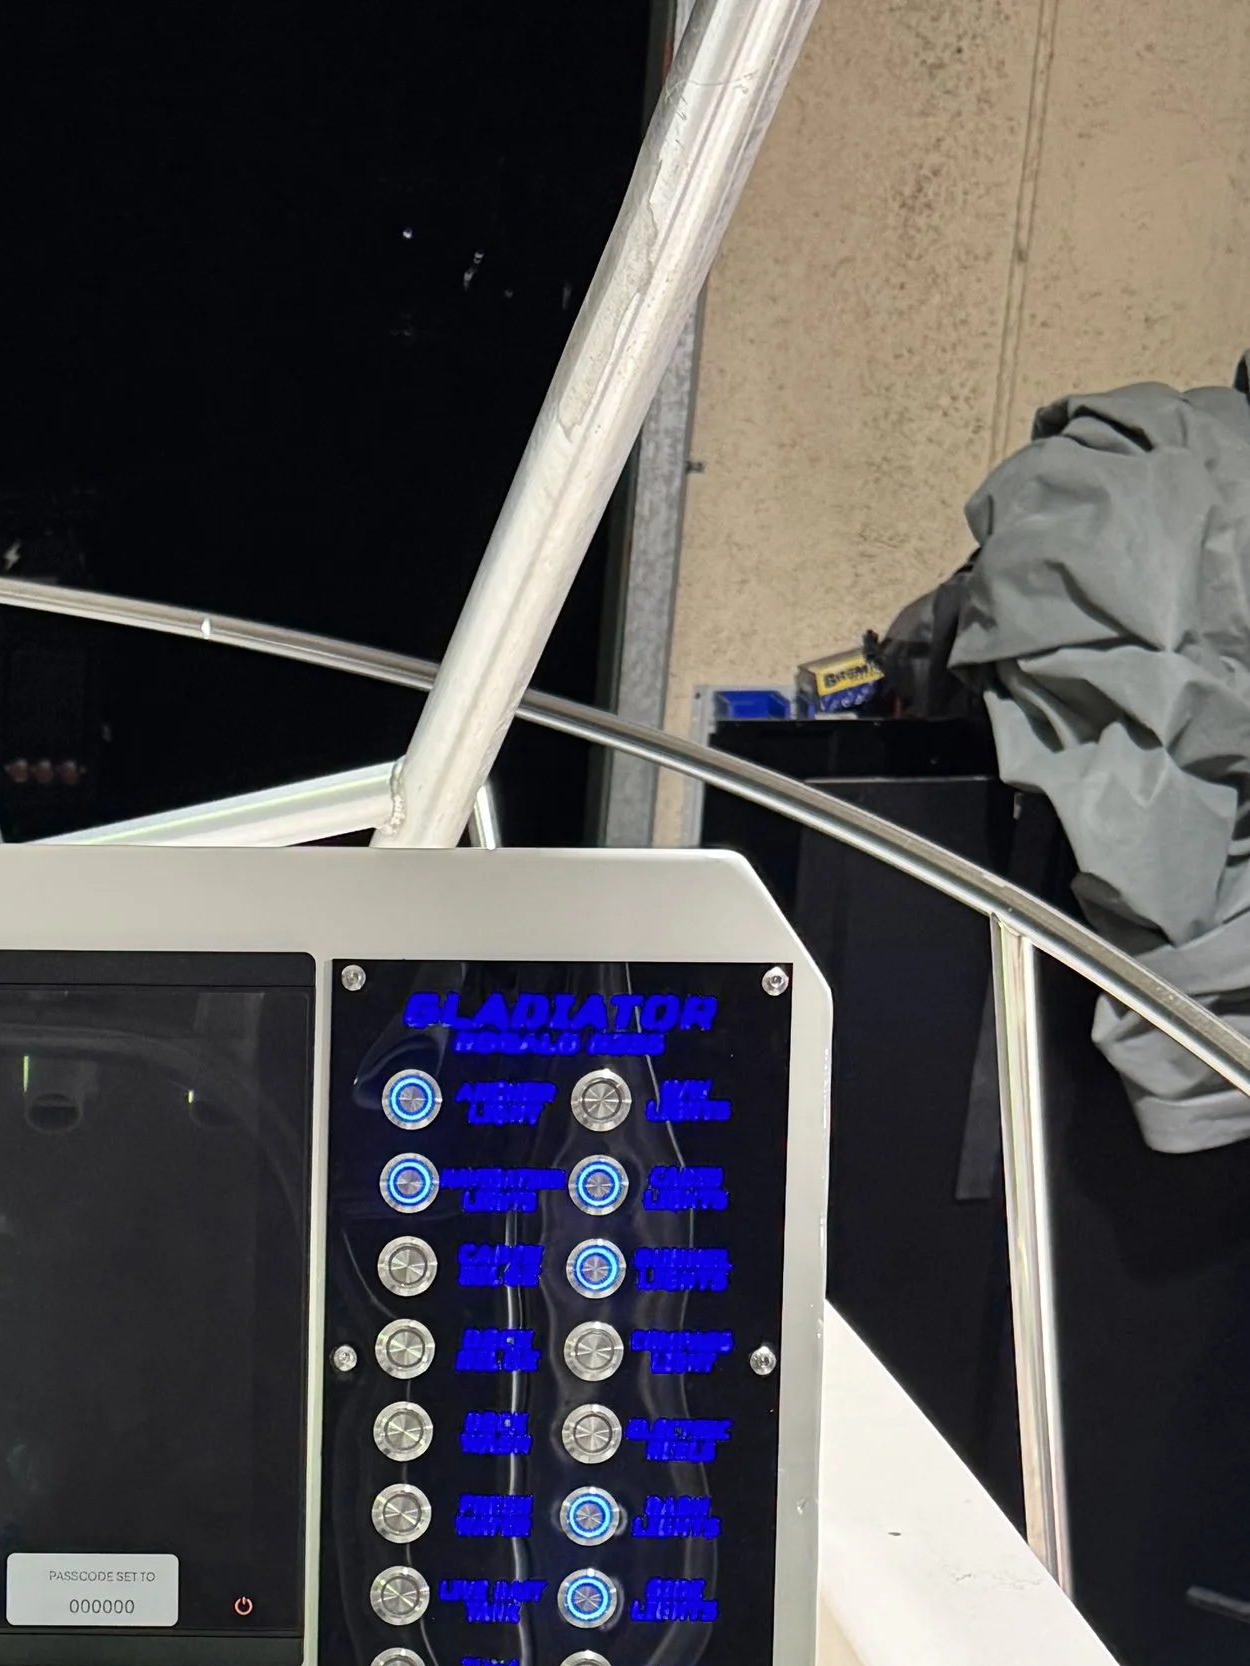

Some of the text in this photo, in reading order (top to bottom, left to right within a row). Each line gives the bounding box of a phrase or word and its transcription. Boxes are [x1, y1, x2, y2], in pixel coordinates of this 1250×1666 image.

[403, 991, 718, 1033] GLADIATOR
[49, 1570, 156, 1582] PASSCODE SET TO
[69, 1599, 135, 1614] 000000
